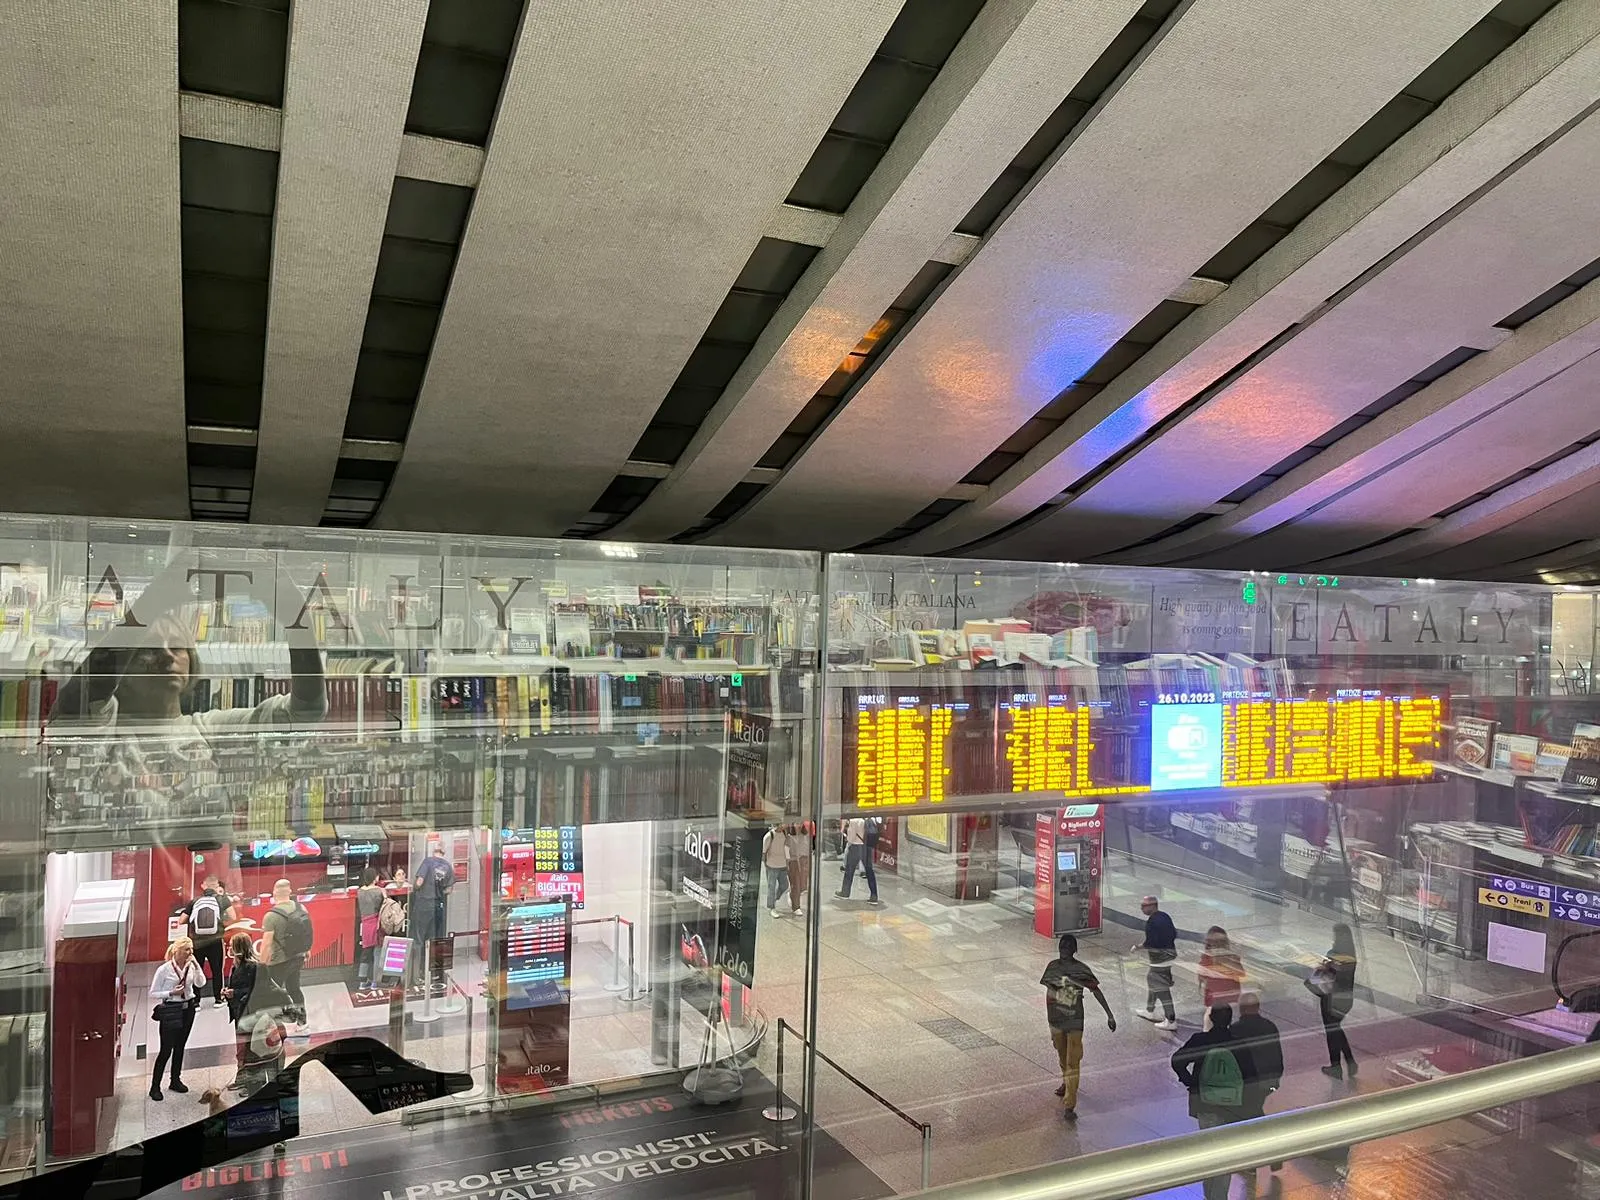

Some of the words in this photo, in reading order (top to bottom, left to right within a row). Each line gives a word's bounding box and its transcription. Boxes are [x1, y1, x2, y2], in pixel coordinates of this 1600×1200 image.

[0, 562, 533, 632] ATALY
[1159, 597, 1183, 618] High
[1288, 601, 1516, 644] EATALY
[1191, 626, 1221, 640] coming
[1013, 693, 1037, 703] ARRIVI
[1158, 692, 1215, 704] 26.10.2023
[534, 829, 559, 839] B354
[561, 830, 574, 839] 01
[534, 840, 559, 849] B353
[562, 841, 574, 849] 01
[684, 826, 712, 865] italo
[535, 851, 559, 860] B352
[562, 851, 574, 860] 01
[535, 861, 559, 871] B351
[562, 861, 575, 871] 03
[537, 881, 581, 892] BIGLIETTI
[1520, 882, 1534, 890] Bus
[1512, 897, 1531, 906] Treni
[1583, 910, 1600, 920] Taxi
[719, 945, 748, 979] italo
[525, 1064, 551, 1076] italo
[181, 1149, 349, 1193] BIGLIETTI
